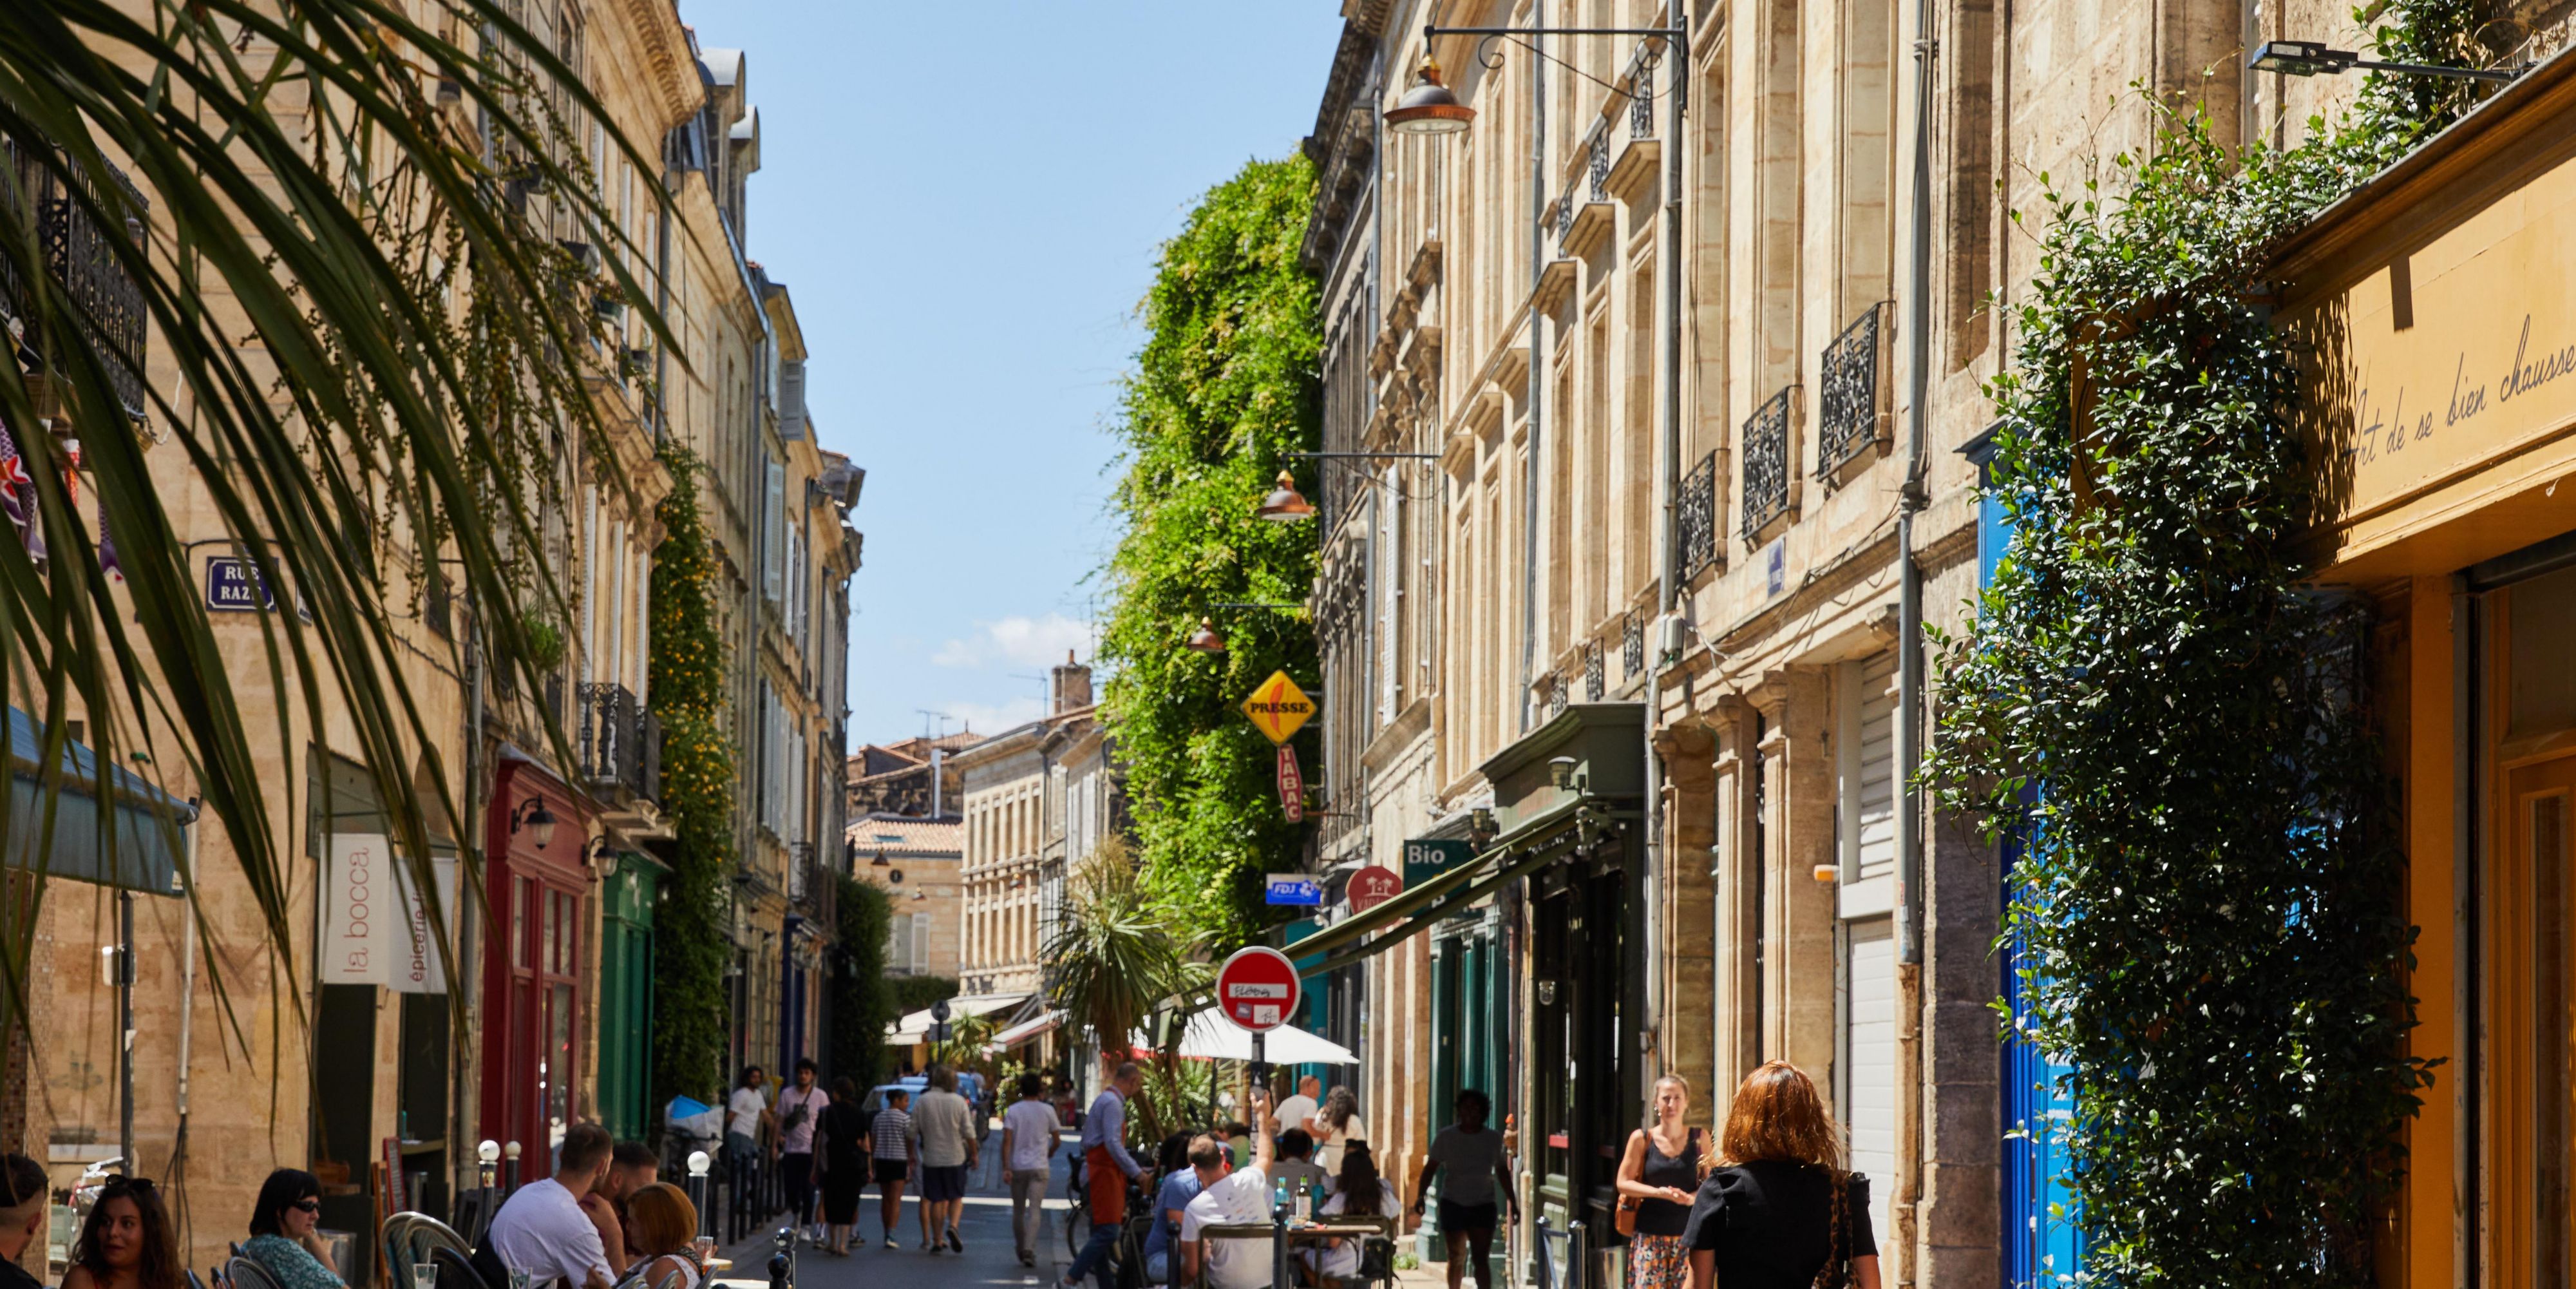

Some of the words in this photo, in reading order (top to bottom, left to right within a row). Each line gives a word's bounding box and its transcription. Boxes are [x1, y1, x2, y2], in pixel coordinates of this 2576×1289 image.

[2387, 386, 2405, 454] de
[2415, 411, 2433, 441] se
[2446, 352, 2487, 428] bien
[225, 566, 260, 580] RUE
[221, 586, 261, 600] RAZ
[1250, 703, 1309, 713] PRESSE
[1281, 747, 1299, 819] TABAC
[1408, 845, 1445, 864] Bio
[344, 847, 369, 937] bocca
[1274, 884, 1296, 894] FDJ
[410, 910, 427, 982] épicerie
[343, 947, 368, 972] la
